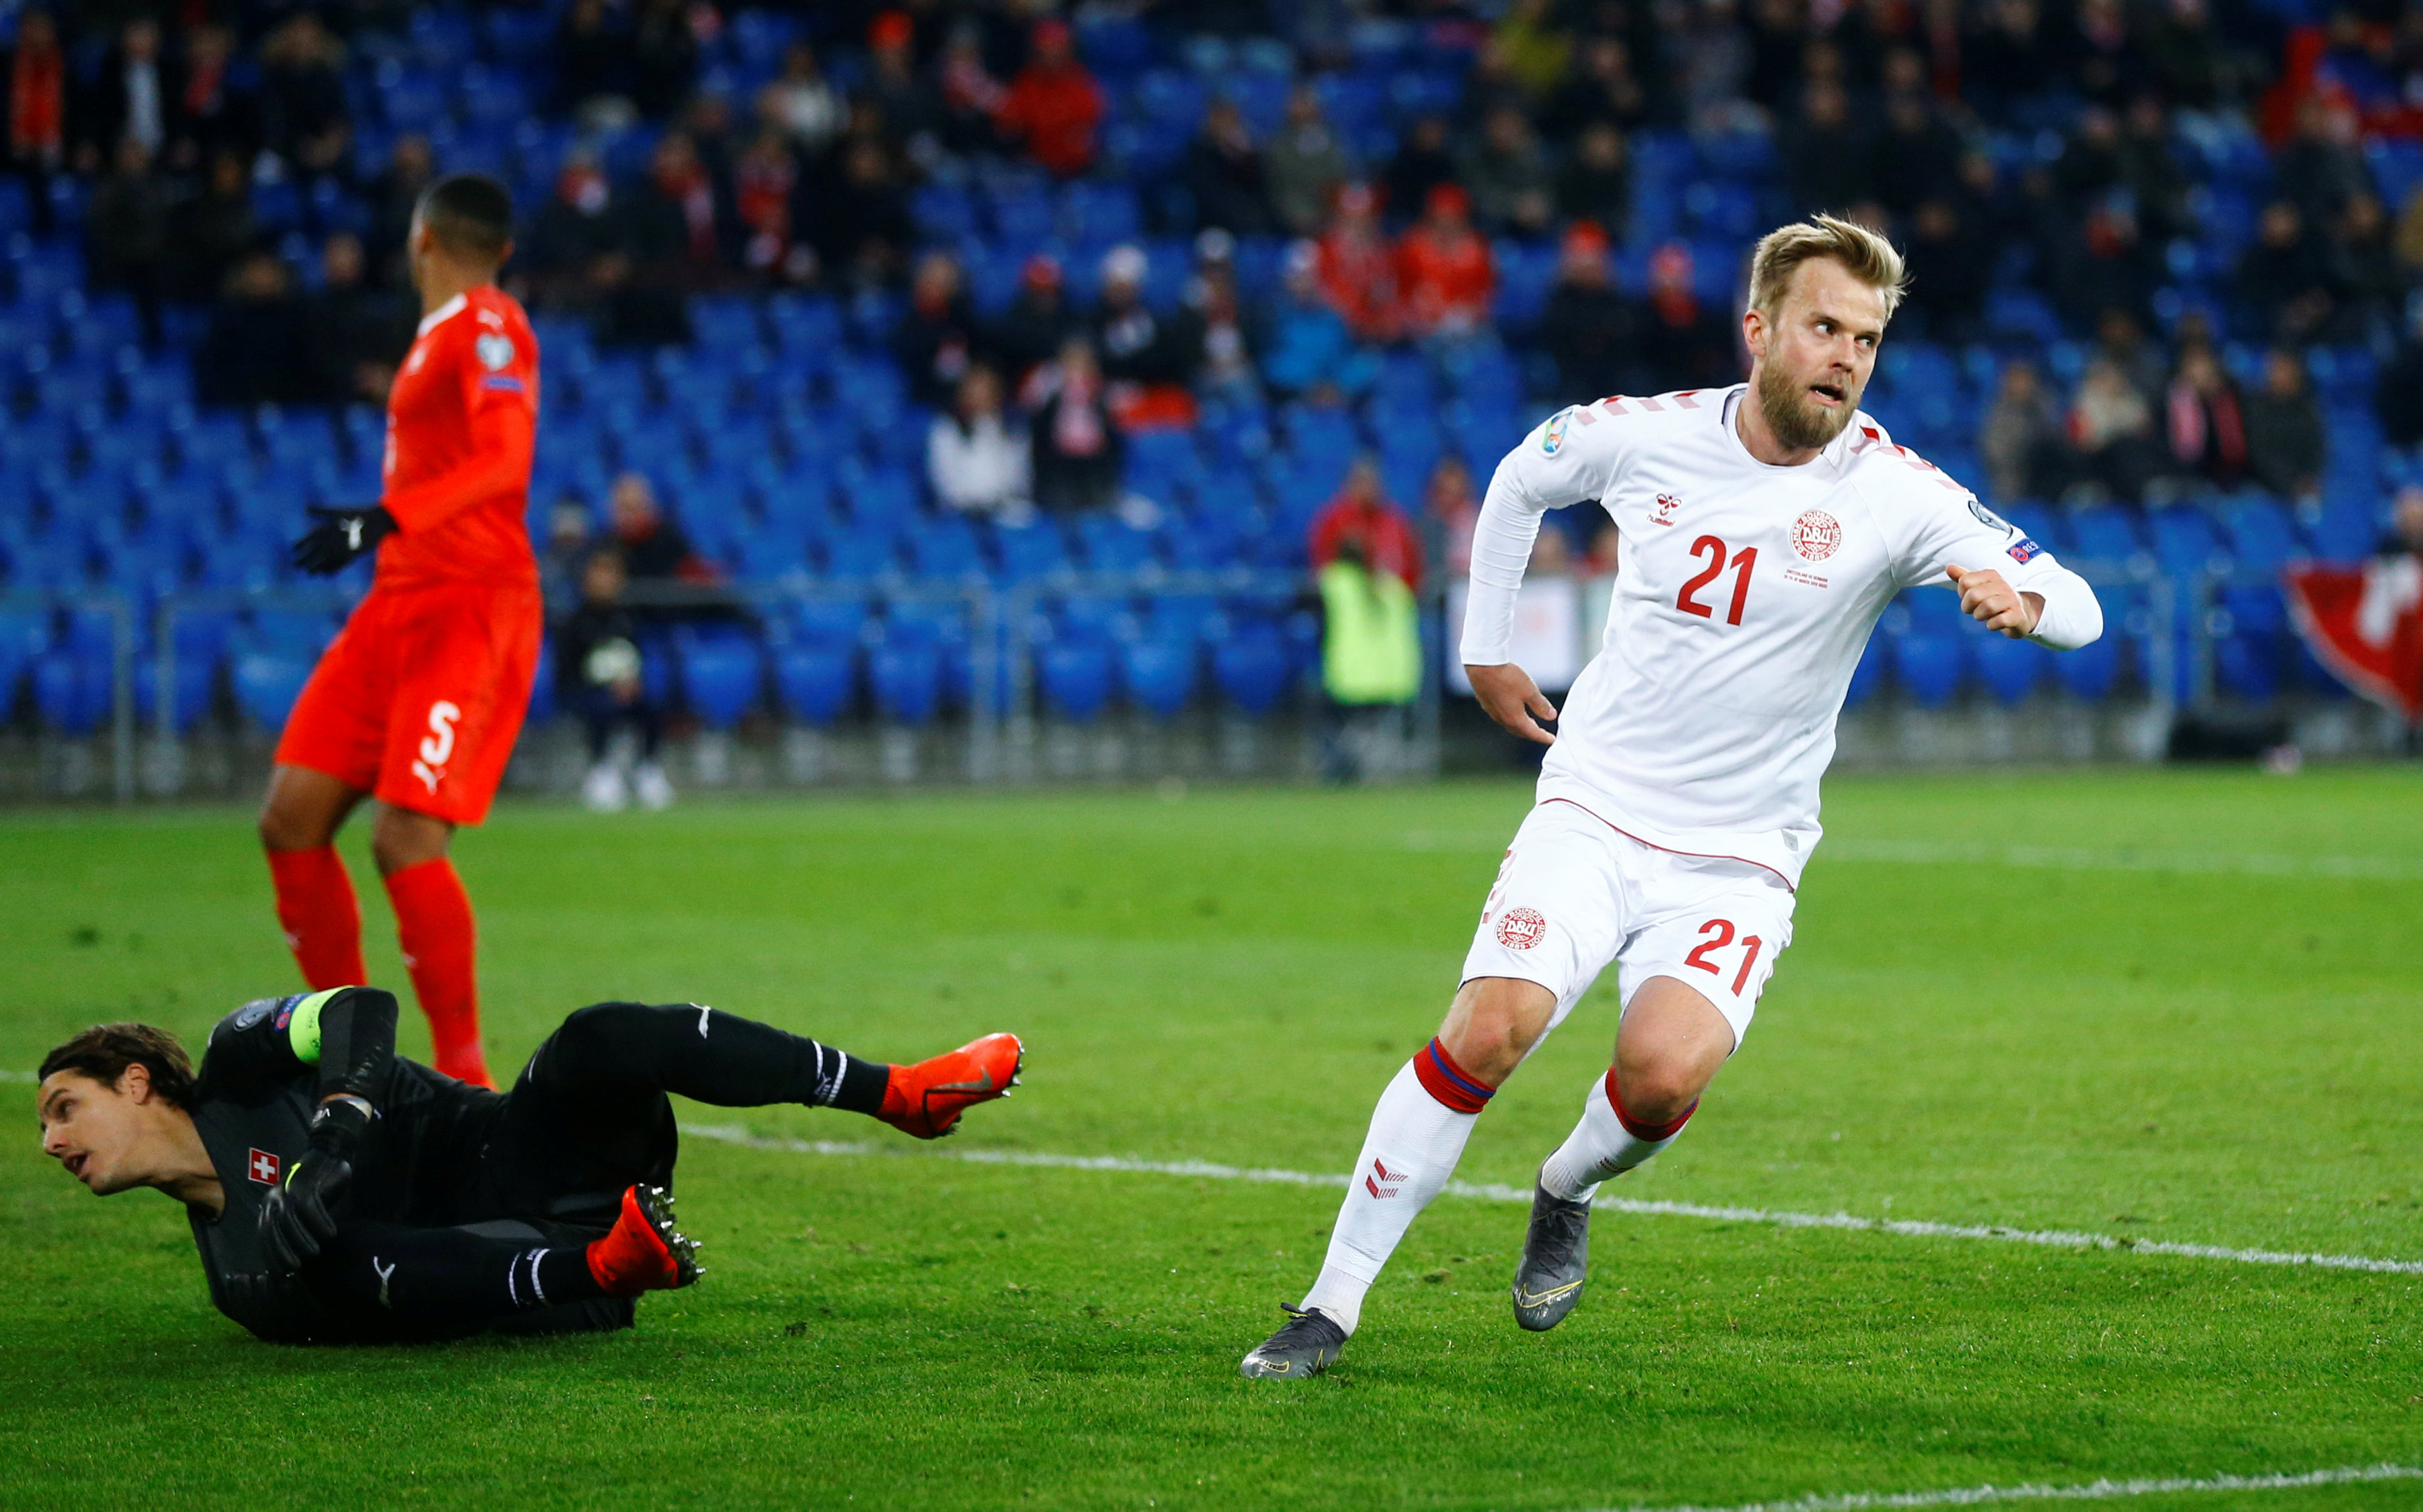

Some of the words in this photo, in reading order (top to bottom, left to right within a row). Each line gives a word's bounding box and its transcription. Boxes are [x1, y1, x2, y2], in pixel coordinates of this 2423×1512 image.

[1801, 526, 1832, 543] DBU
[1676, 534, 1758, 627] 21
[420, 700, 461, 766] 5
[1505, 920, 1537, 937] DBU
[1684, 919, 1762, 998] 21
